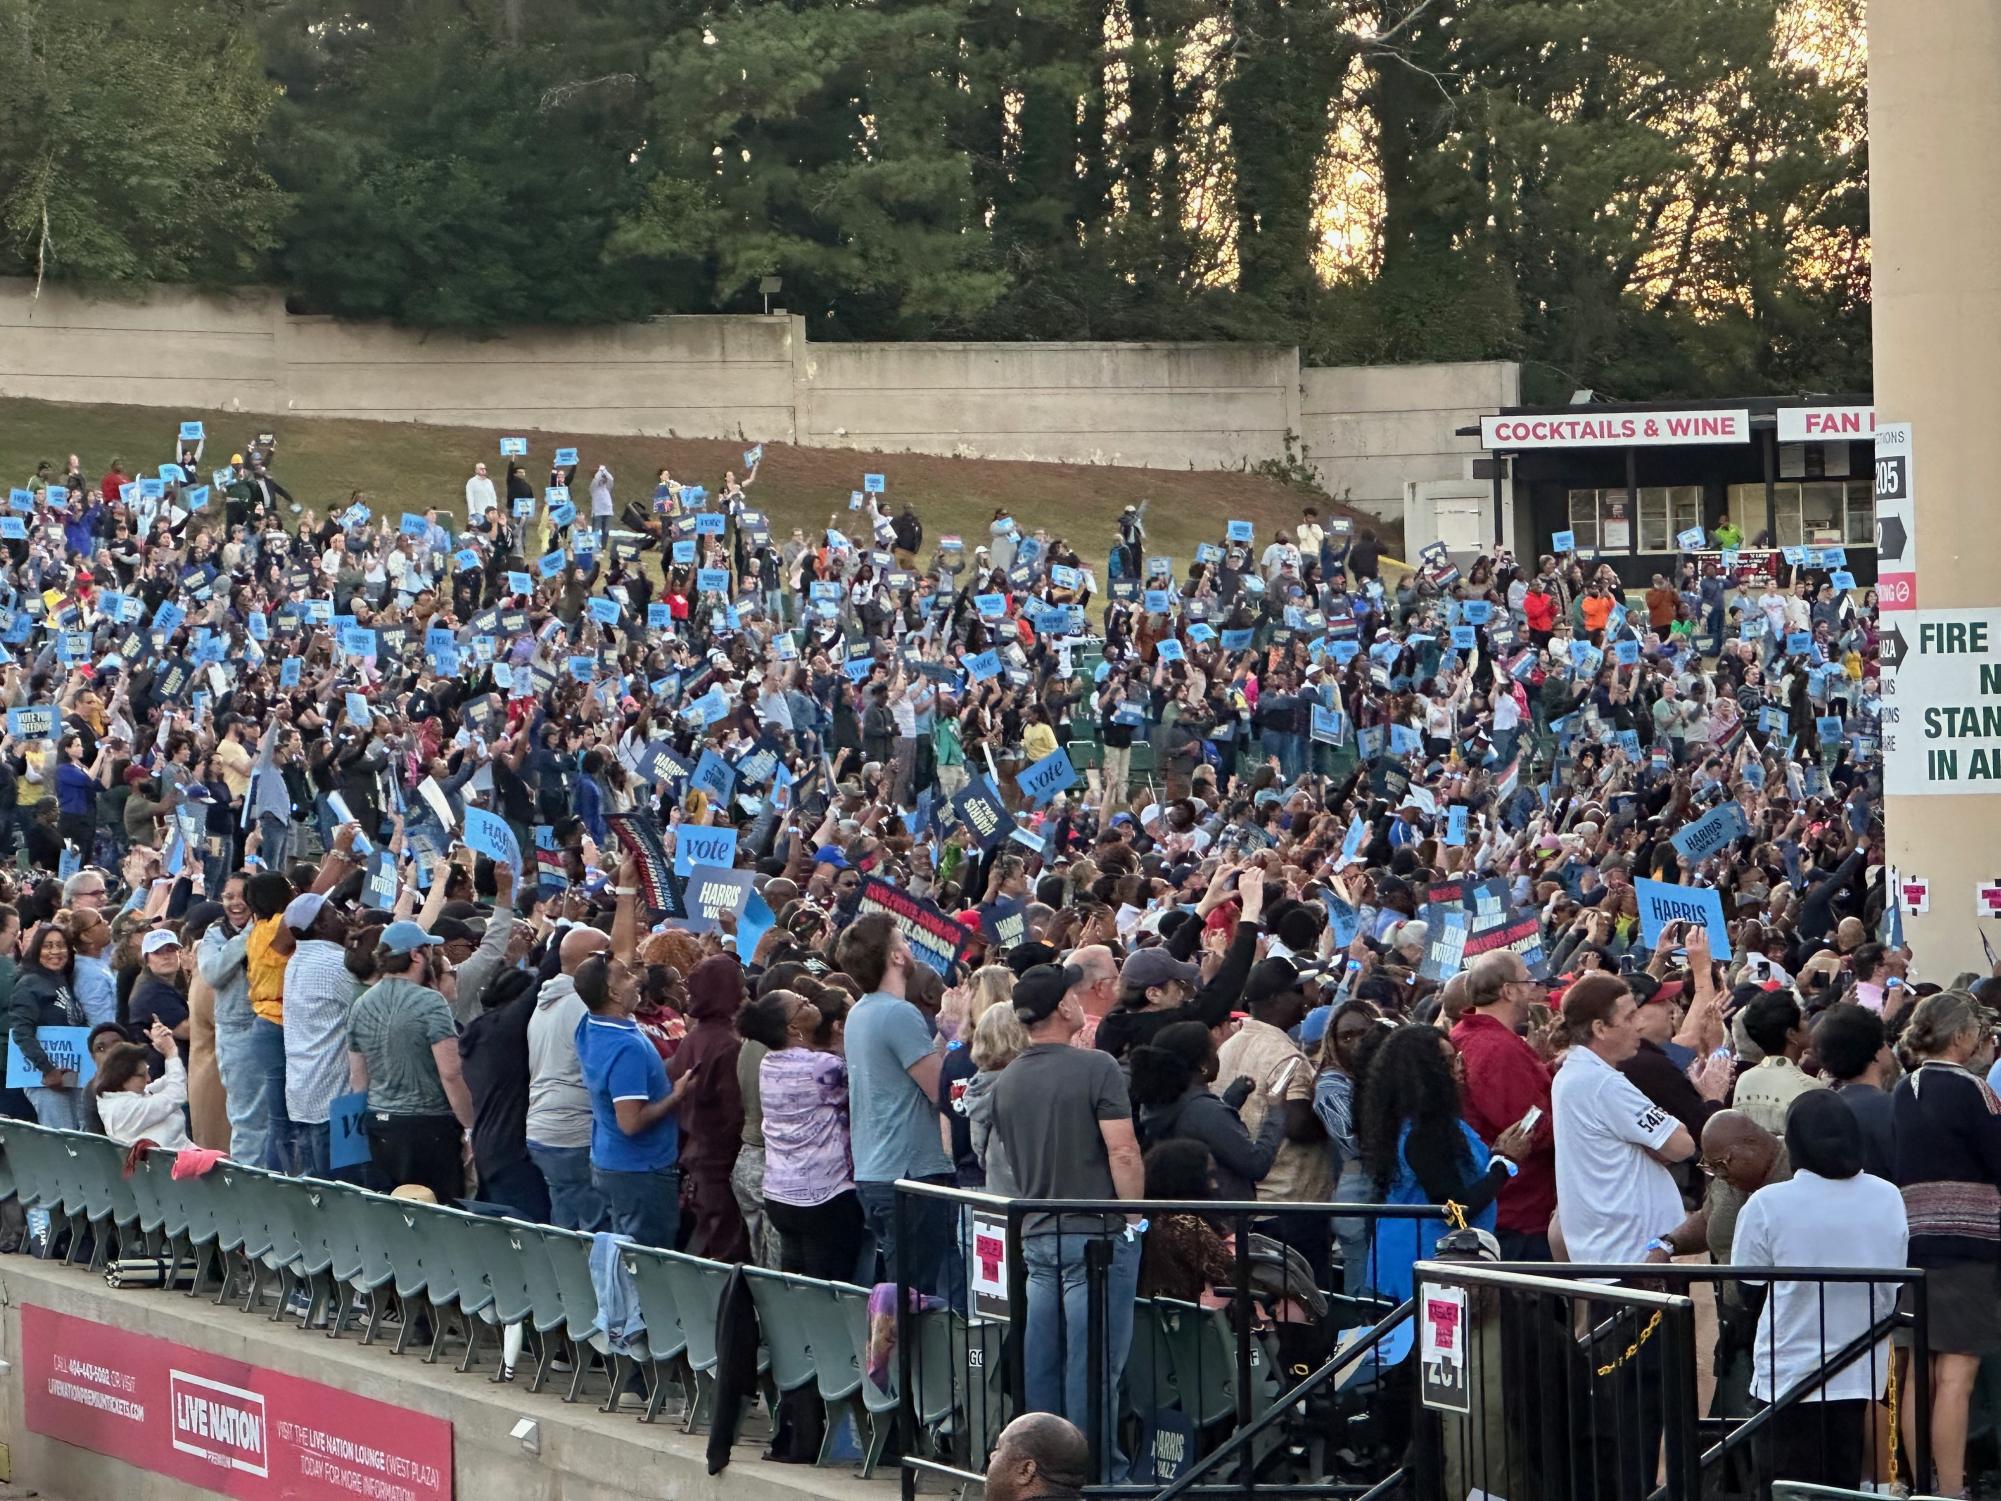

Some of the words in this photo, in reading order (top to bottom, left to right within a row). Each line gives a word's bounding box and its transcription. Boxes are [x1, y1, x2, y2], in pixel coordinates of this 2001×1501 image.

[1495, 419, 1636, 441] COCKTAILS
[1643, 418, 1660, 438] &
[1666, 416, 1736, 437] WINE
[1805, 412, 1860, 433] FAN
[1920, 622, 1989, 655] FIRE
[1924, 706, 2001, 739] STAN
[1027, 758, 1064, 793] vote
[1928, 749, 1958, 781] IN
[963, 798, 996, 837] HARRIS
[686, 837, 730, 861] vote
[1684, 818, 1723, 851] HARRIS
[698, 881, 742, 908] HARRIS
[1651, 896, 1708, 928] HARRIS
[177, 1391, 209, 1437] LIVE
[208, 1401, 261, 1454] NATION
[277, 1420, 293, 1442] VISIT
[294, 1424, 309, 1447] THE
[309, 1426, 326, 1452] LIVE
[325, 1433, 355, 1462] NATION
[355, 1443, 386, 1471] LOUNGE
[385, 1454, 411, 1481] (WEST
[411, 1462, 440, 1491] PLAZA)
[1151, 1429, 1185, 1463] HARRIS
[300, 1455, 324, 1479] TODAY
[324, 1462, 340, 1485] FOR
[338, 1467, 363, 1494] MORE
